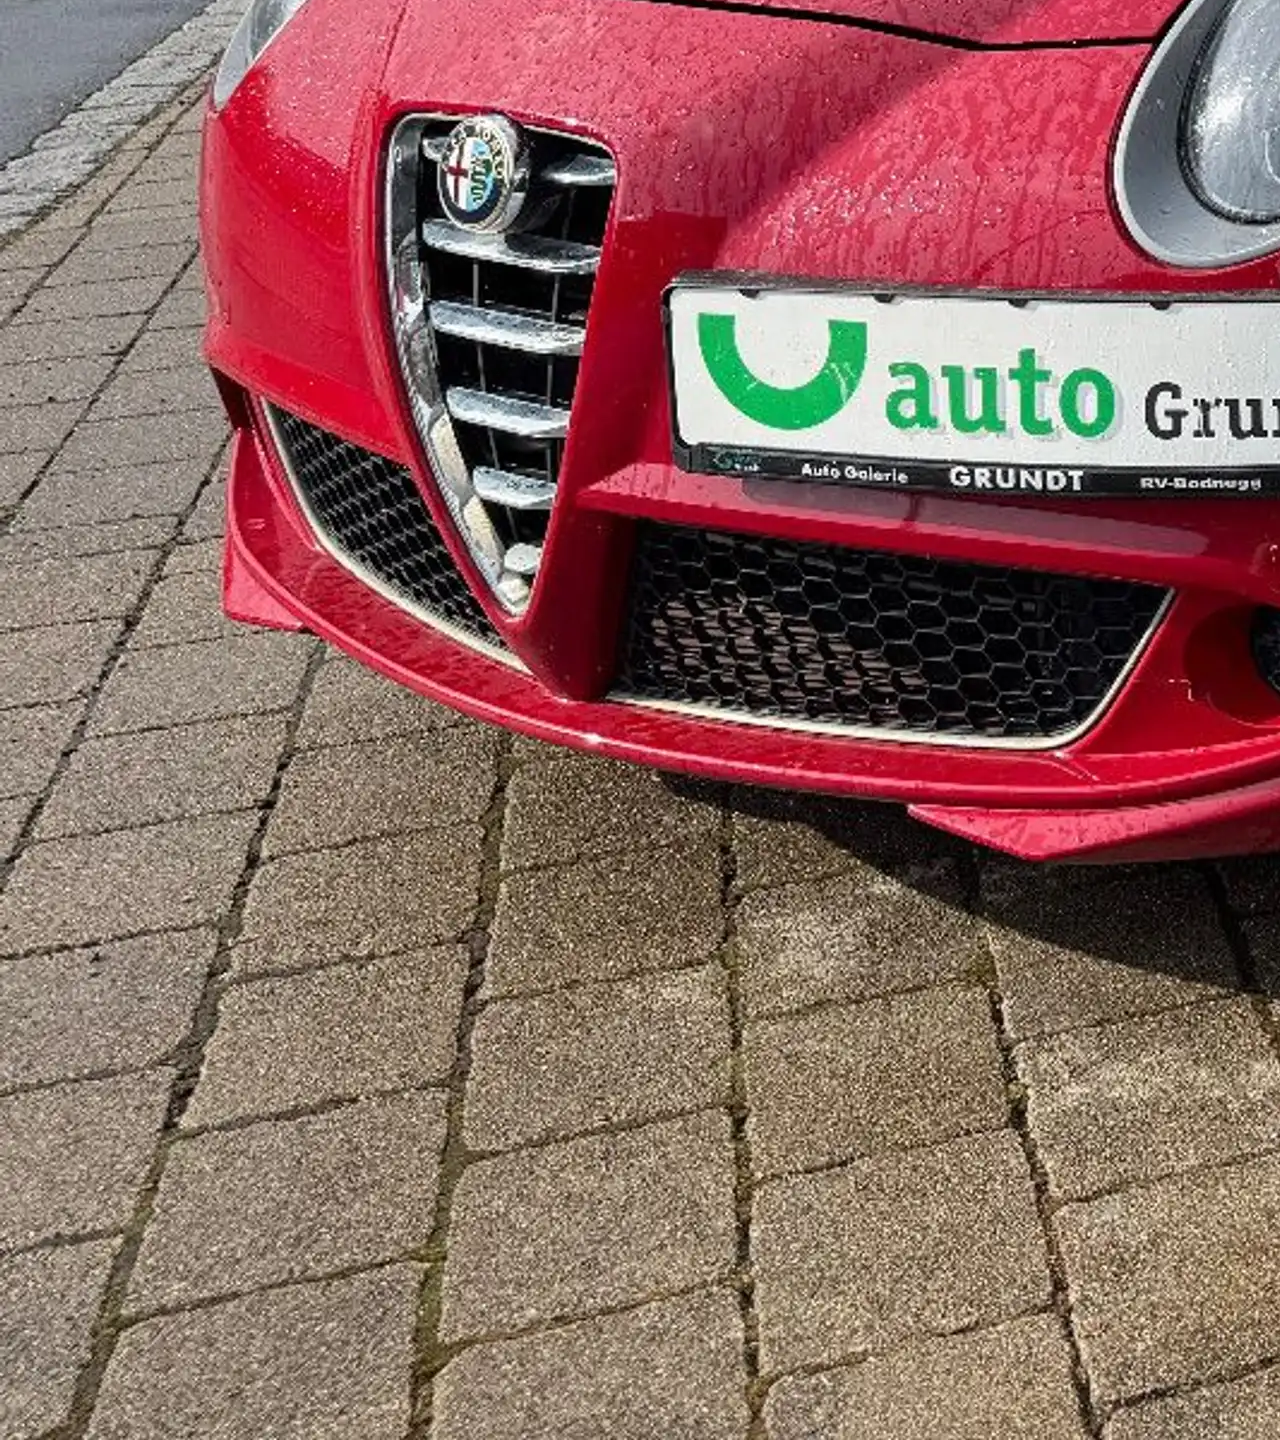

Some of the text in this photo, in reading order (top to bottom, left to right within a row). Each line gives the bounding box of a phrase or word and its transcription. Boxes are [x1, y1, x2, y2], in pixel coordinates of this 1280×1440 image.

[886, 348, 1116, 438] auto
[801, 462, 841, 479] Auto
[844, 465, 909, 484] Galerie
[949, 465, 1084, 491] GRUNDT
